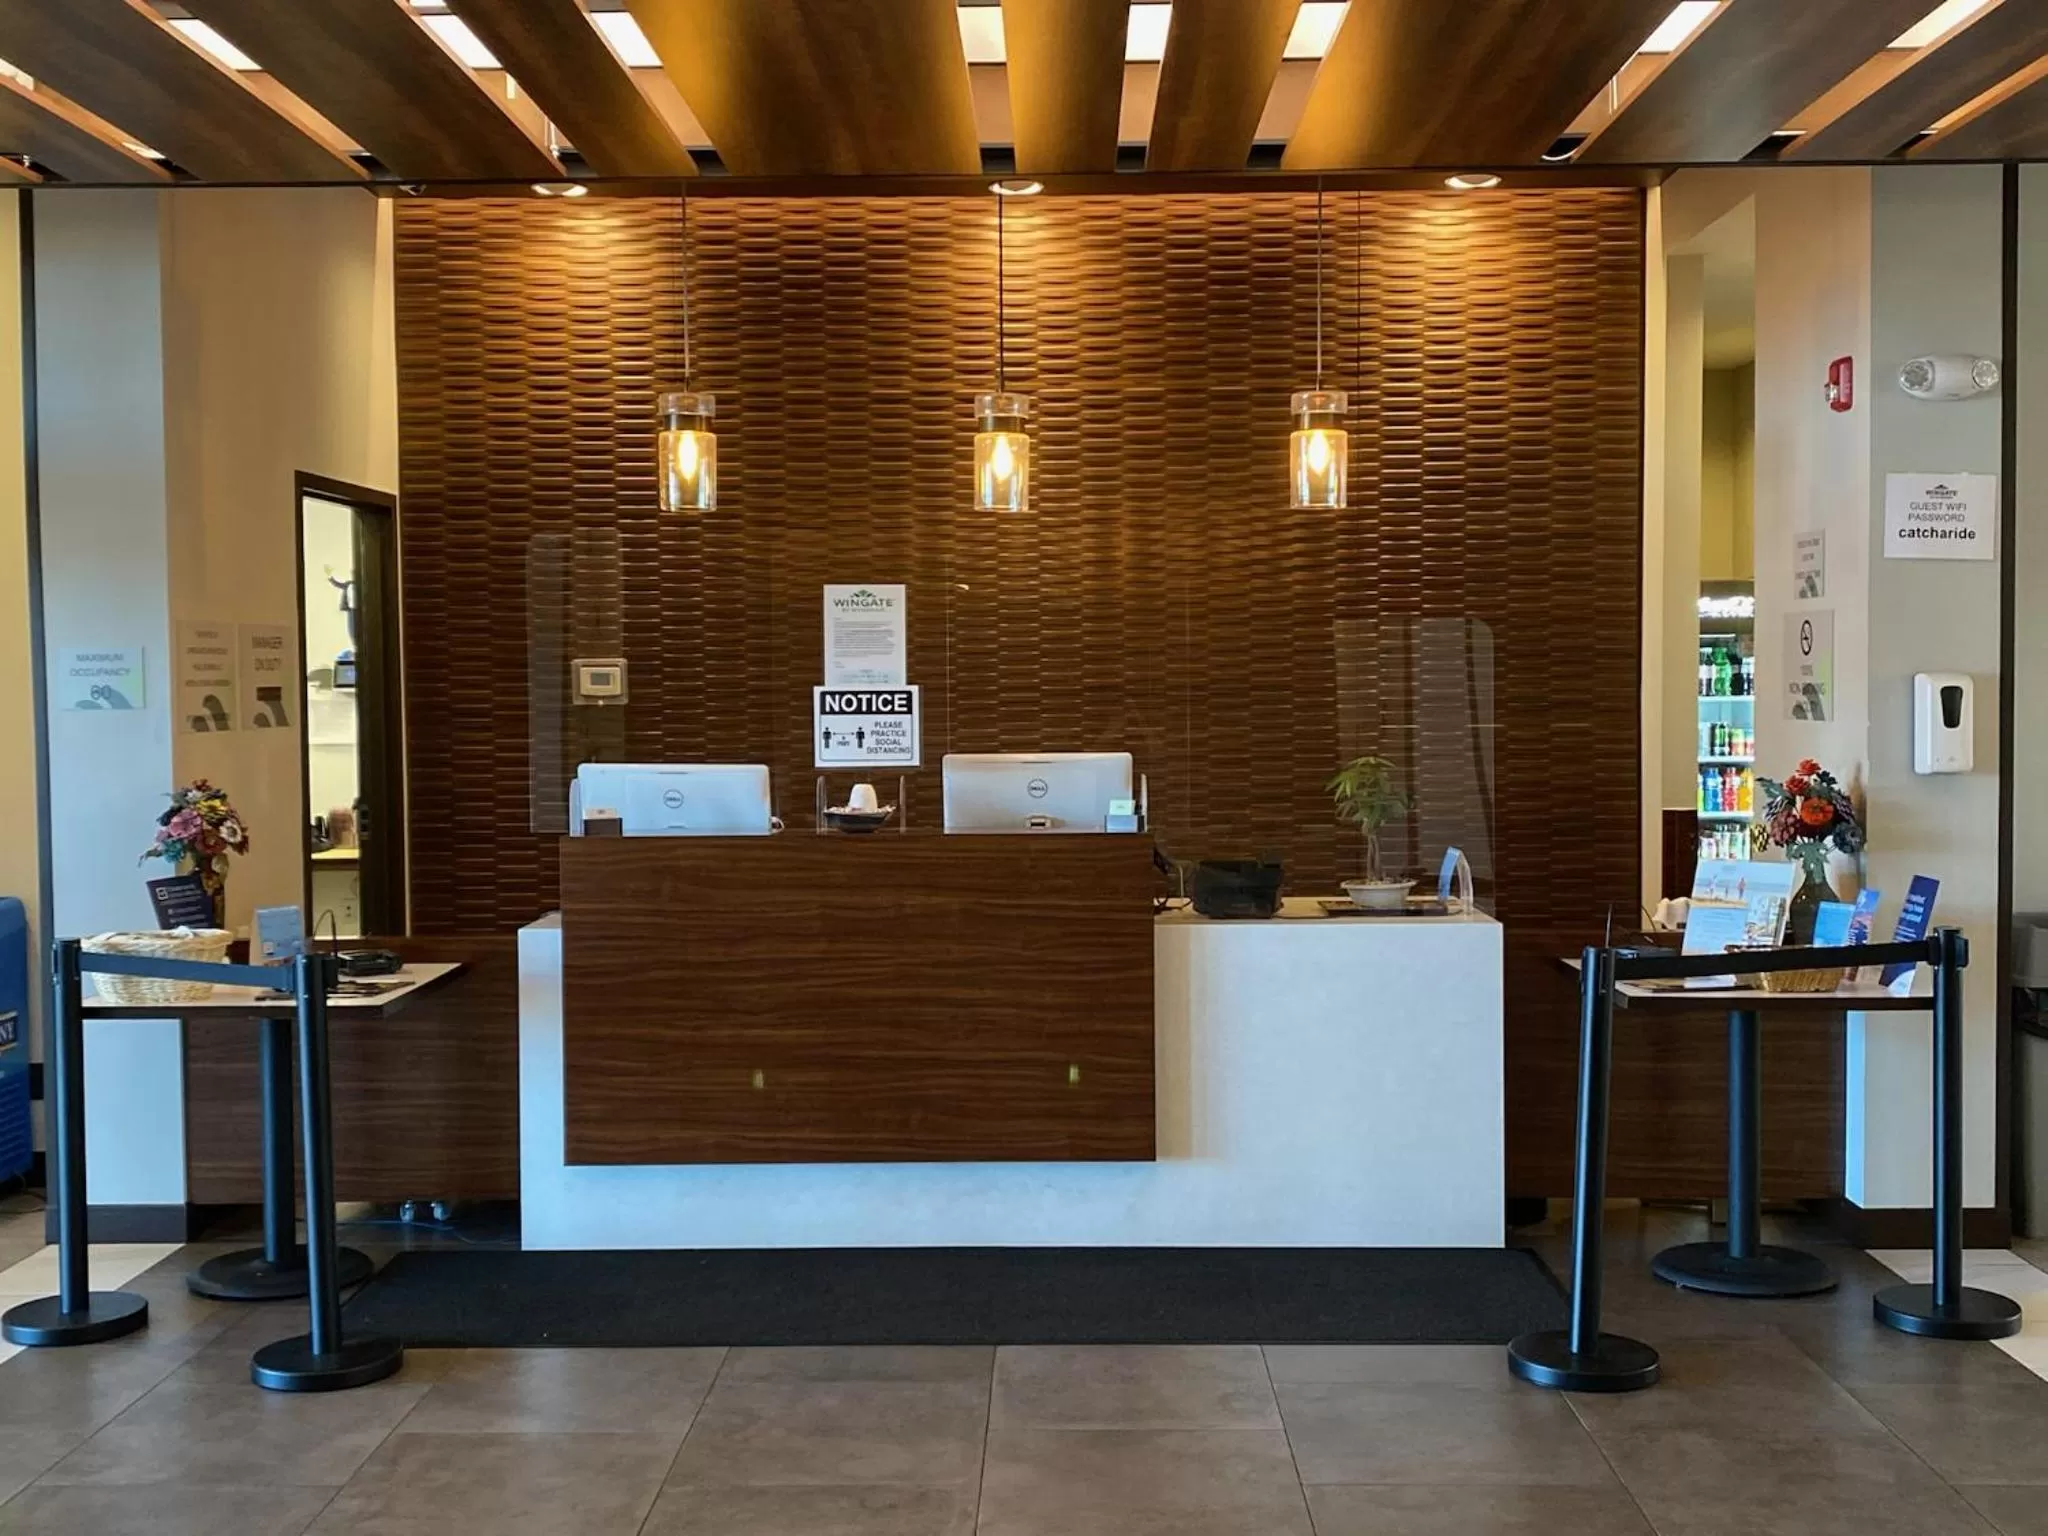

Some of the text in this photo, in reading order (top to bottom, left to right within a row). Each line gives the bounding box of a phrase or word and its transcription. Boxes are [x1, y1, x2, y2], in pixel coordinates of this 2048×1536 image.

[1909, 502, 1943, 511] GUEST
[1908, 513, 1965, 522] PASSWORD
[1898, 527, 1977, 540] catcharide
[833, 599, 894, 607] WINGATE
[75, 653, 124, 661] MAXIMUM
[69, 667, 130, 677] OCCUPANCY
[825, 694, 908, 713] NOTICE
[875, 738, 901, 746] SOCIAL
[866, 746, 911, 755] DISTANCING
